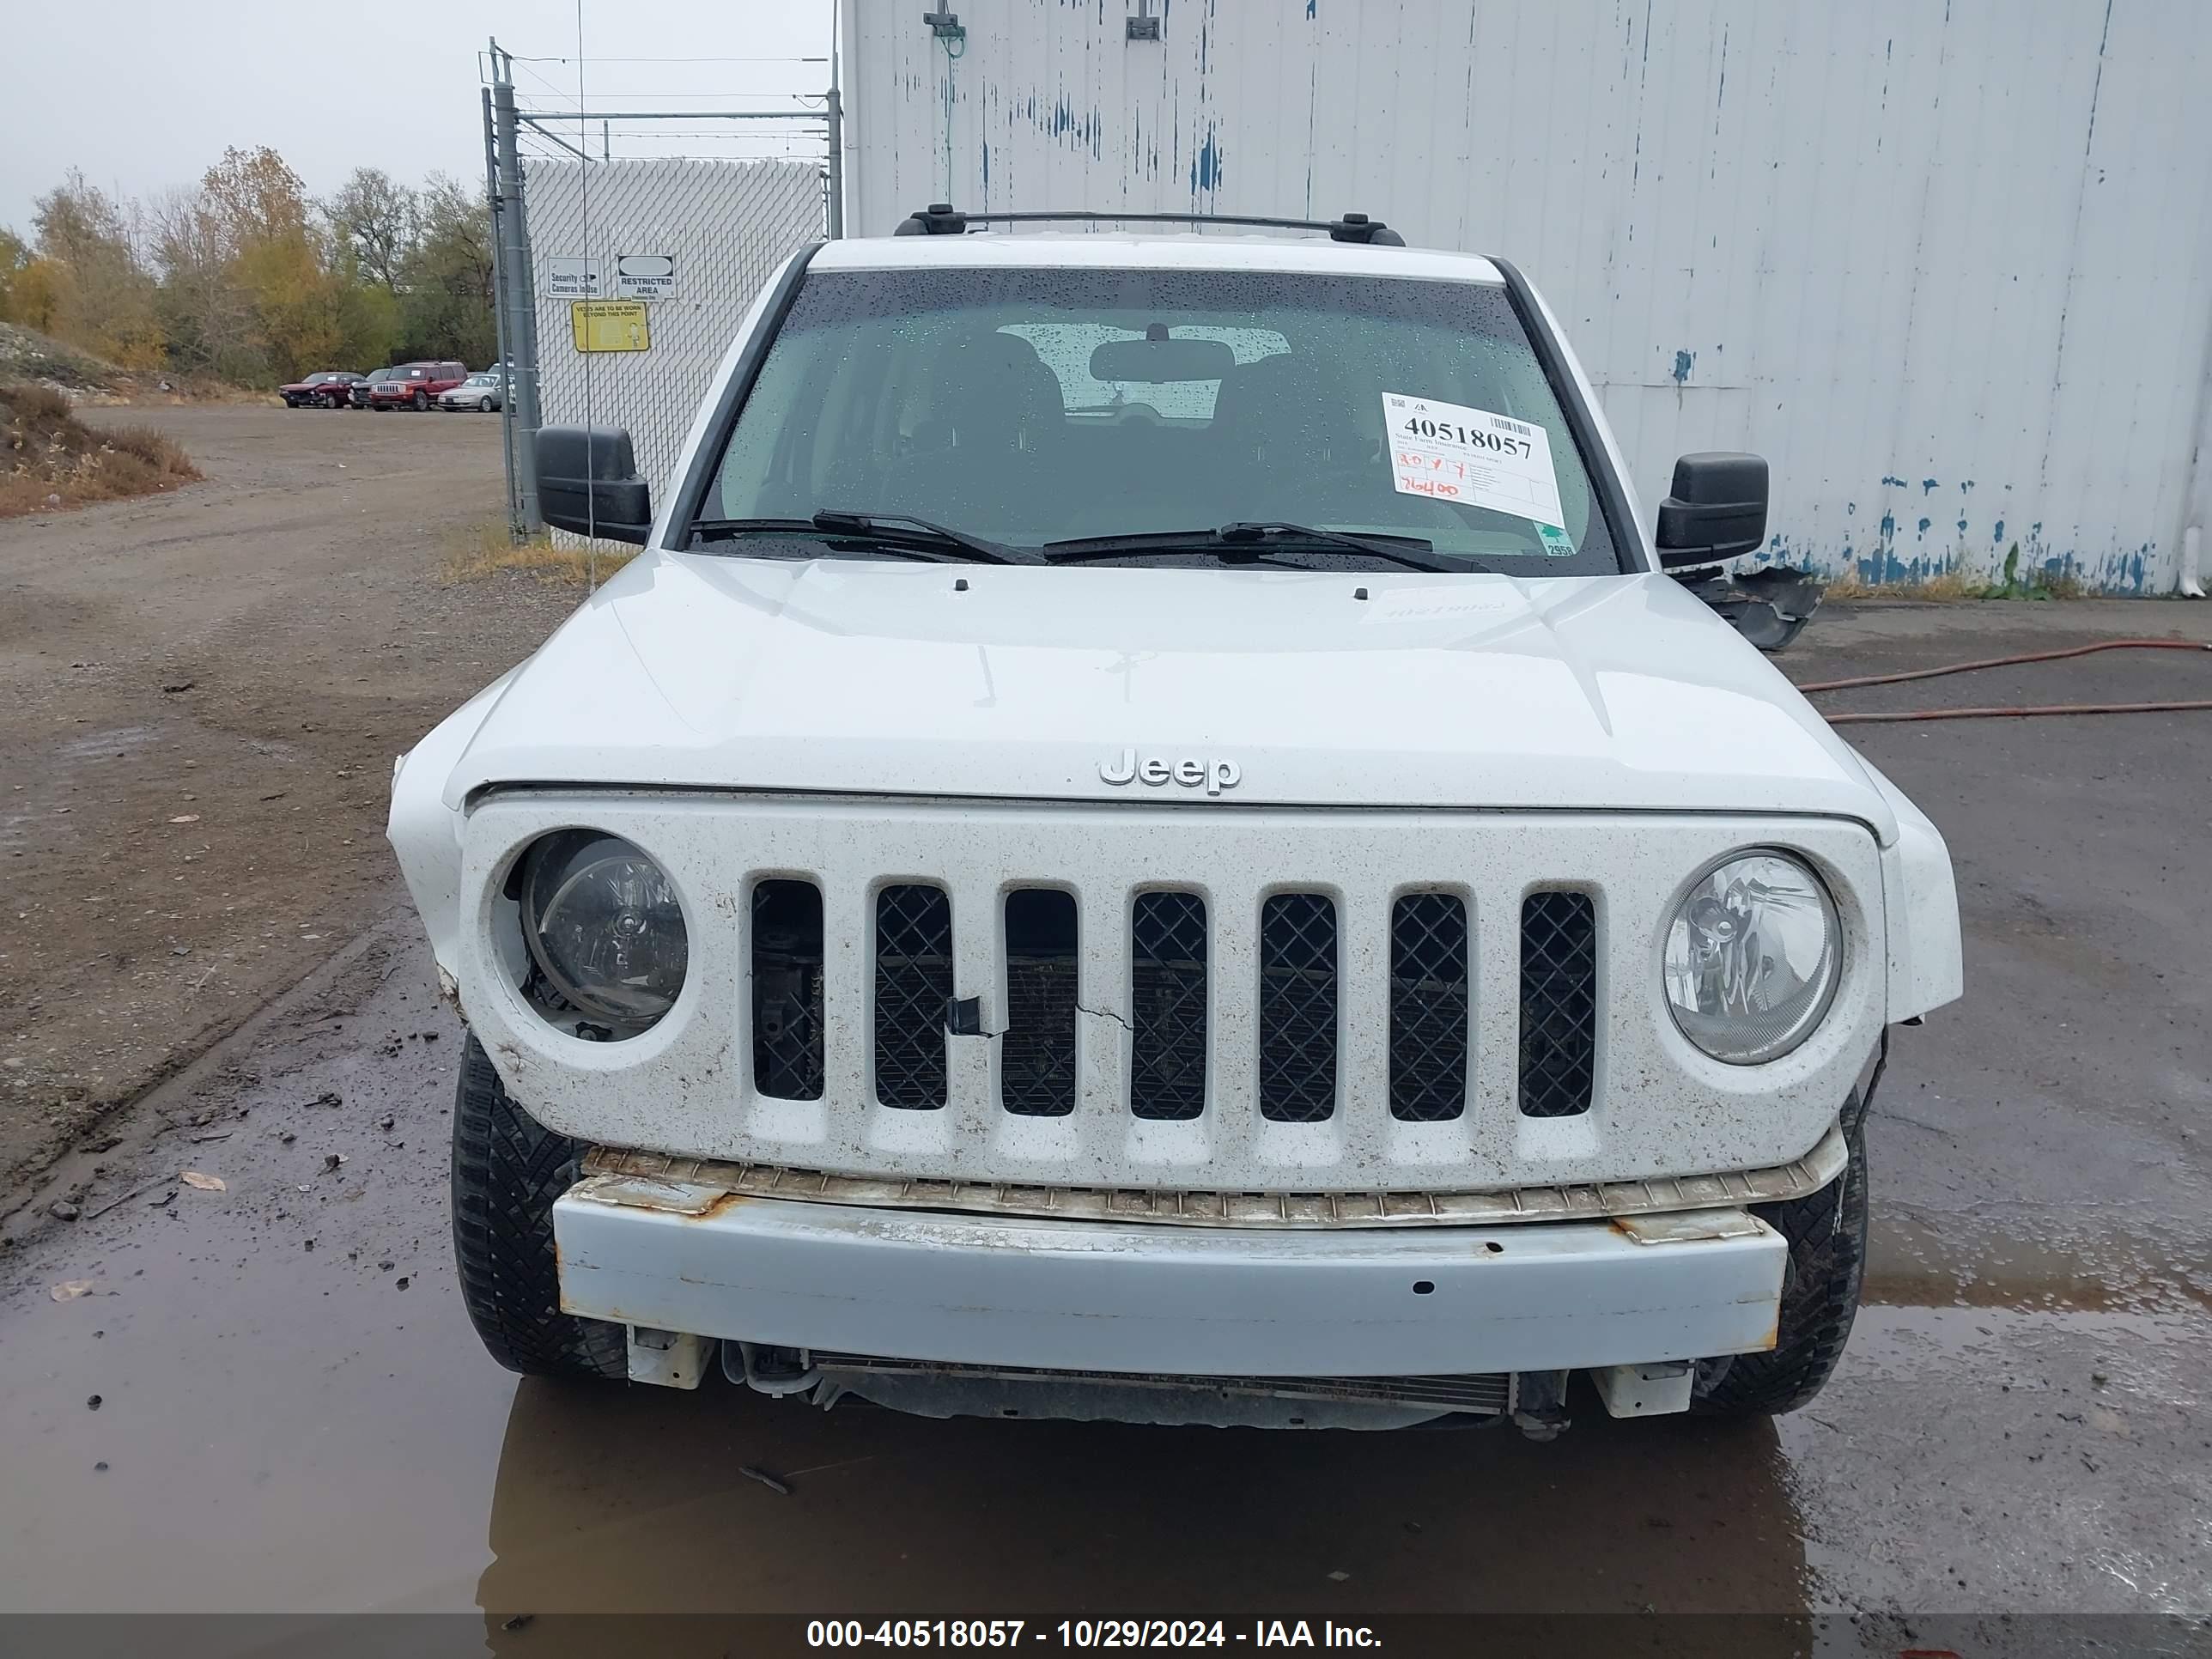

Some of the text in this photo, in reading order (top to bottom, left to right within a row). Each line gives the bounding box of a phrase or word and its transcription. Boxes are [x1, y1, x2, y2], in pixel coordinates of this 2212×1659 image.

[551, 273, 578, 283] Security
[552, 283, 578, 293] Cameras
[1404, 417, 1531, 459] 40518057
[1414, 435, 1433, 444] Farm
[1434, 438, 1468, 451] Insurance
[1548, 544, 1574, 556] 2958
[1099, 748, 1242, 797] Jeep
